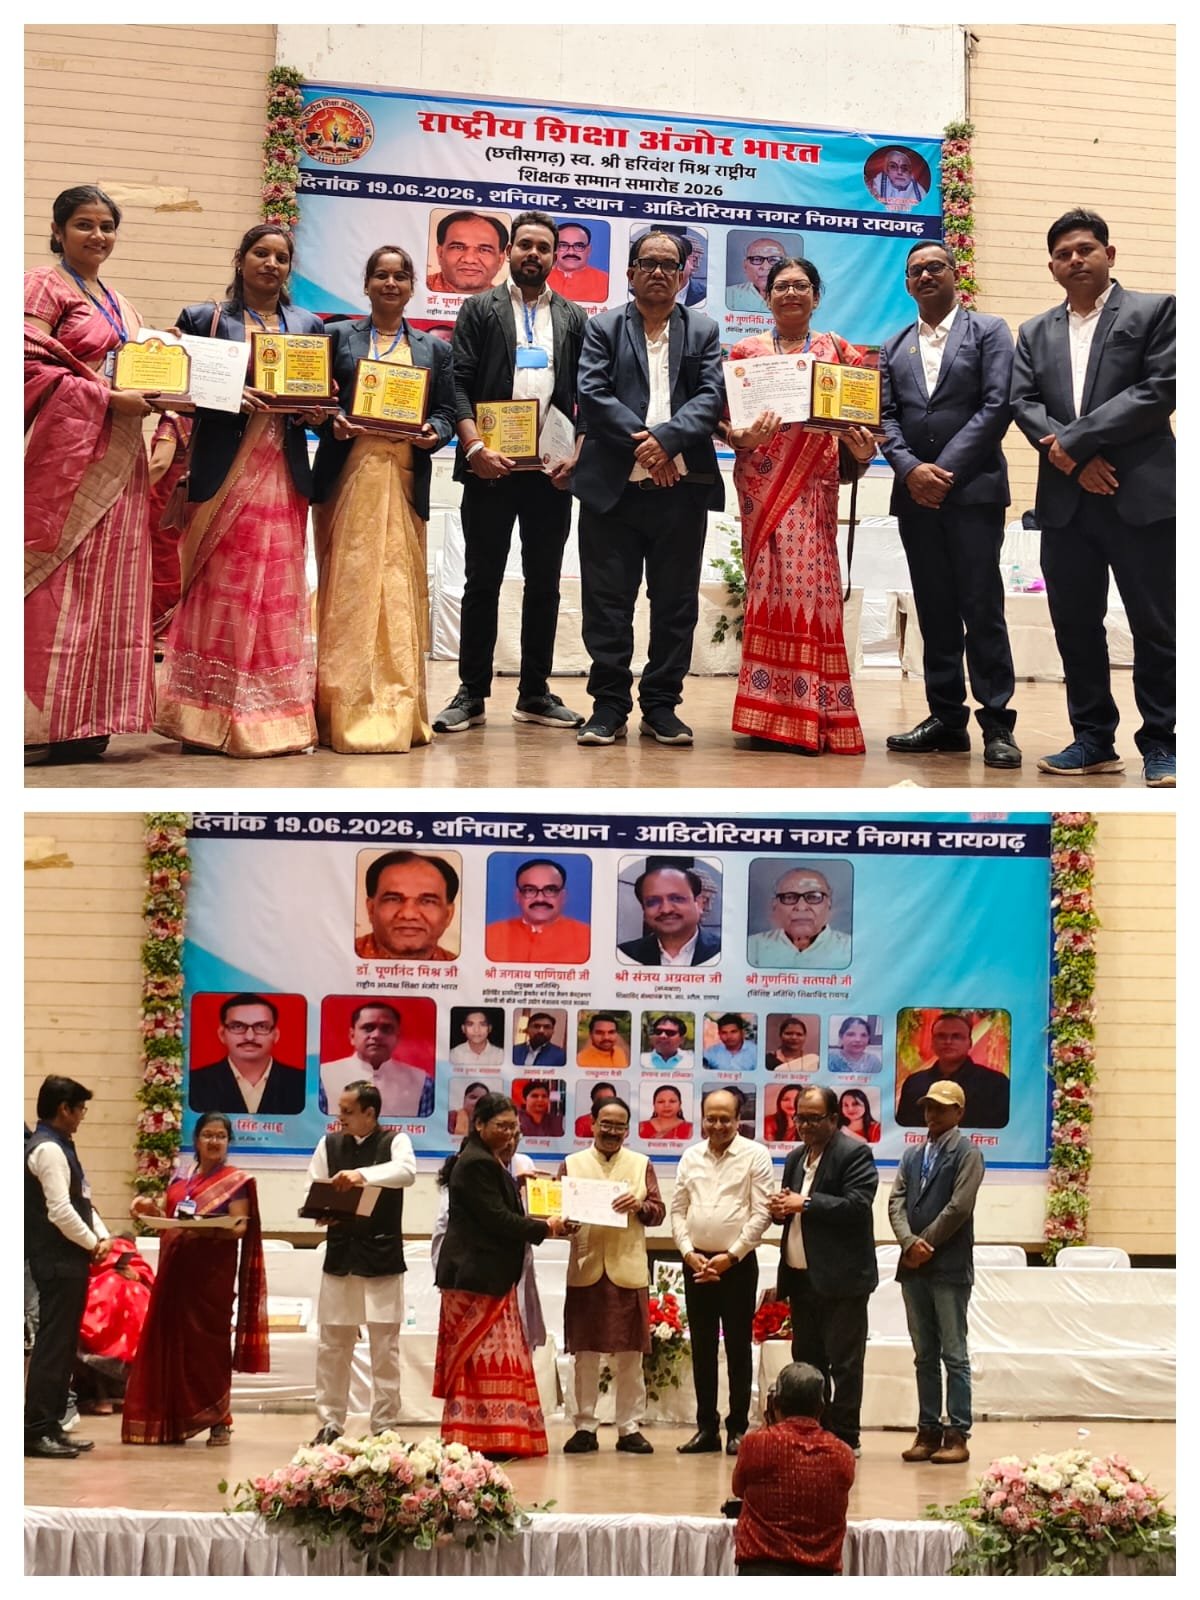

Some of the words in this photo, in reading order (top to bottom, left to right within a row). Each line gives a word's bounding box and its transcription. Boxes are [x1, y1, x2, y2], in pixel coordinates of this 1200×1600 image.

[417, 110, 527, 140] राष्ट्रीय
[534, 116, 630, 149] शिक्षा
[639, 126, 734, 157] अंजोर
[743, 137, 823, 165] भारत
[485, 145, 566, 168] (छत्तीसगढ़)
[570, 153, 595, 168] स्व.
[600, 153, 622, 171] श्री
[625, 155, 677, 173] हरिवंश
[679, 158, 710, 176] मिश्र
[714, 163, 757, 180] राष्ट्रीय
[518, 166, 571, 186] शिक्षक
[575, 174, 620, 190] सम्मान
[625, 176, 679, 194] समारोह
[684, 182, 724, 197] 2026
[297, 173, 361, 193] दिनांक
[365, 180, 483, 203] 19.06.2026,
[488, 187, 569, 211] शनिवार,
[573, 194, 623, 212] स्थान
[642, 200, 752, 221] आडिटोरियम
[756, 210, 802, 226] नगर
[805, 208, 859, 229] निगम
[862, 217, 926, 237] रायगढ़
[186, 812, 268, 832] दिनांक
[273, 815, 424, 839] 19.06.2026,
[432, 816, 536, 842] शनिवार,
[542, 822, 611, 842] स्थान
[634, 821, 785, 845] आडिटोरियम
[789, 828, 852, 846] नगर
[856, 825, 933, 848] निगम
[937, 831, 1026, 853] रायगढ़
[417, 965, 441, 977] मिश्र
[445, 965, 458, 978] जी
[485, 966, 497, 979] श्री
[579, 968, 590, 980] जी
[615, 969, 629, 982] श्री
[632, 970, 661, 982] संजय
[665, 972, 705, 983] अग्रवाल
[709, 971, 723, 984] जी
[745, 972, 758, 985] श्री
[840, 974, 852, 987] जी
